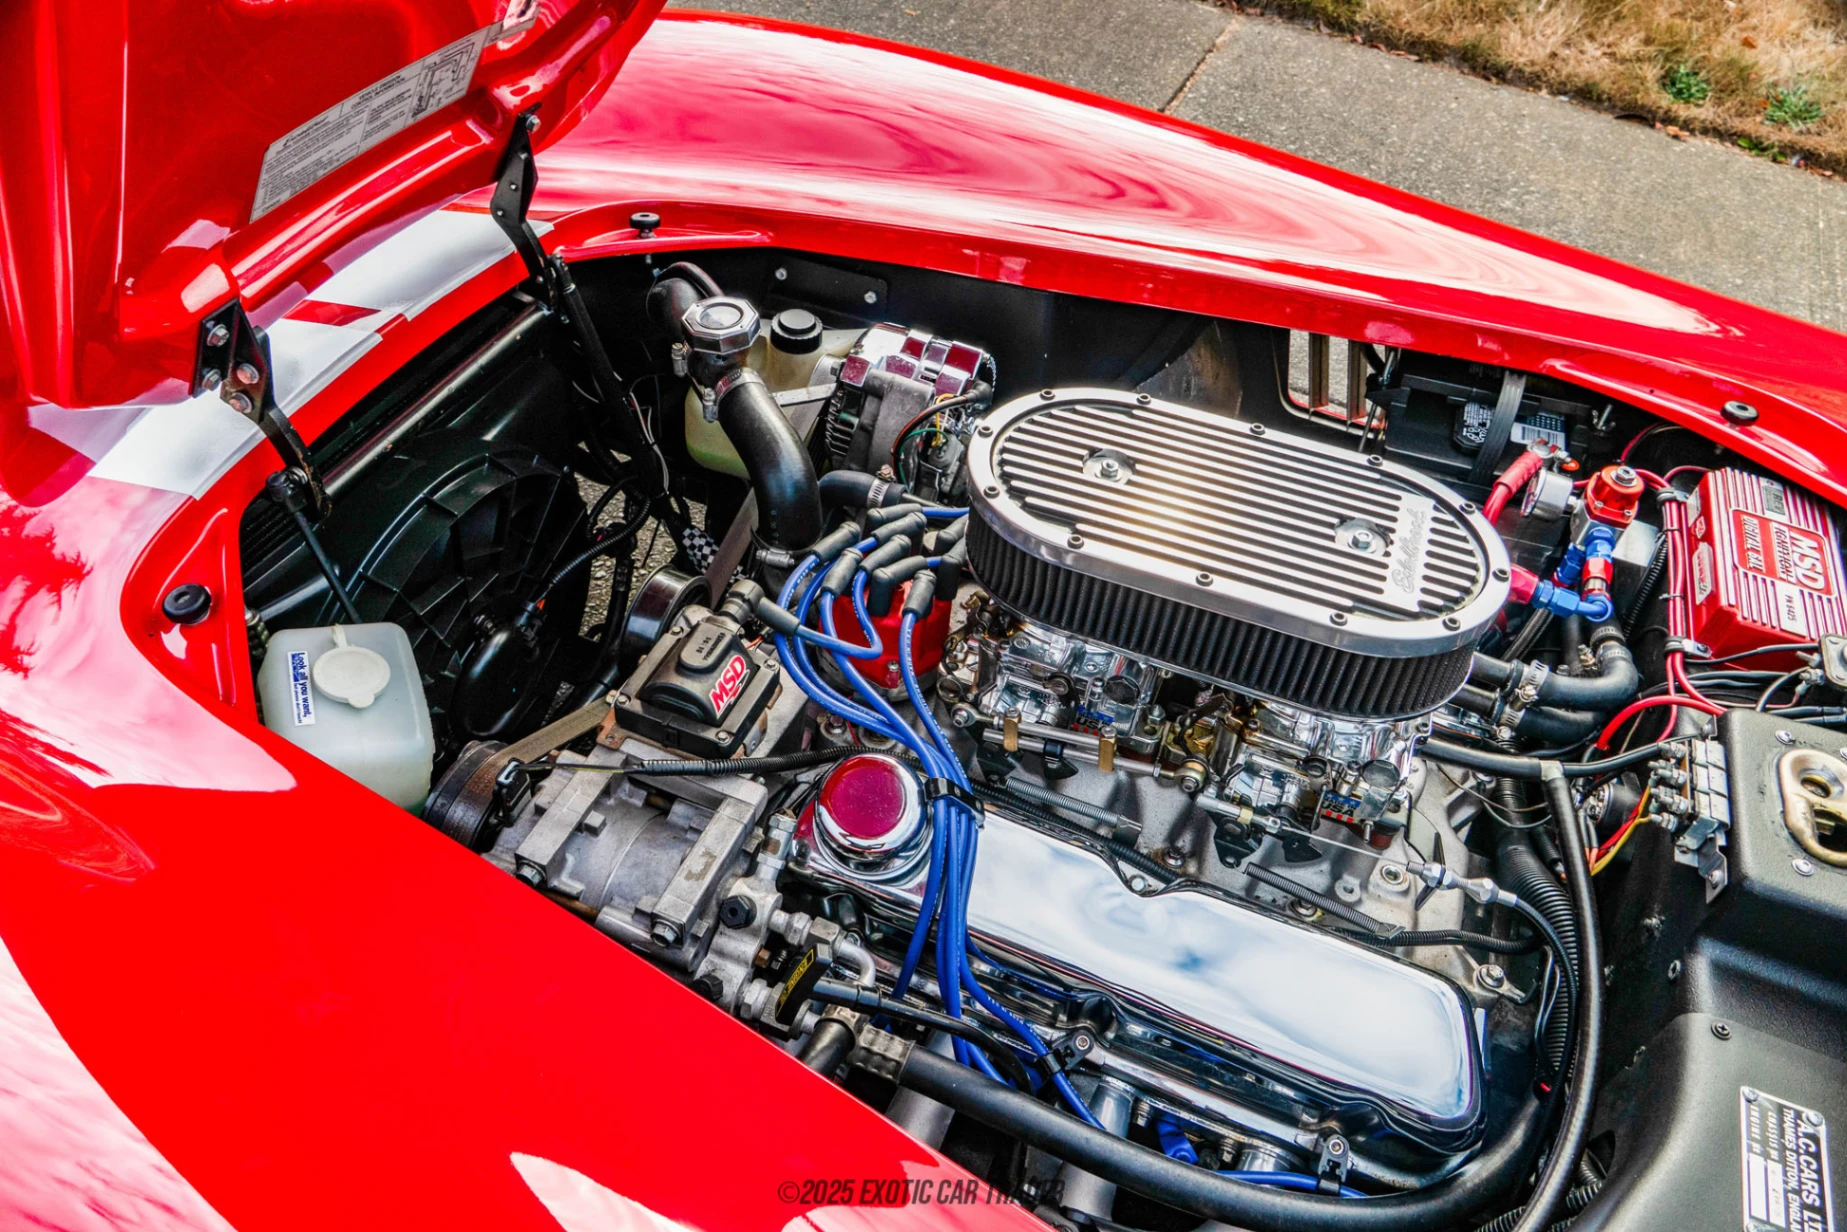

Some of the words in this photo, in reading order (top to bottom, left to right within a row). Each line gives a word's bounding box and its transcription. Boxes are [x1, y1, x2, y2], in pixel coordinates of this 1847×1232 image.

[1392, 508, 1427, 593] Edelbrock
[1774, 526, 1794, 583] IGNITION
[1790, 532, 1825, 590] MSD
[298, 652, 307, 670] Look
[300, 671, 308, 681] all
[299, 682, 308, 695] you
[709, 655, 746, 713] MSD
[302, 698, 312, 717] want,
[1320, 800, 1354, 816] USA
[1750, 1106, 1761, 1140] ENGINE
[1766, 1112, 1778, 1149] CHASSIS
[1783, 1108, 1797, 1149] THAMES
